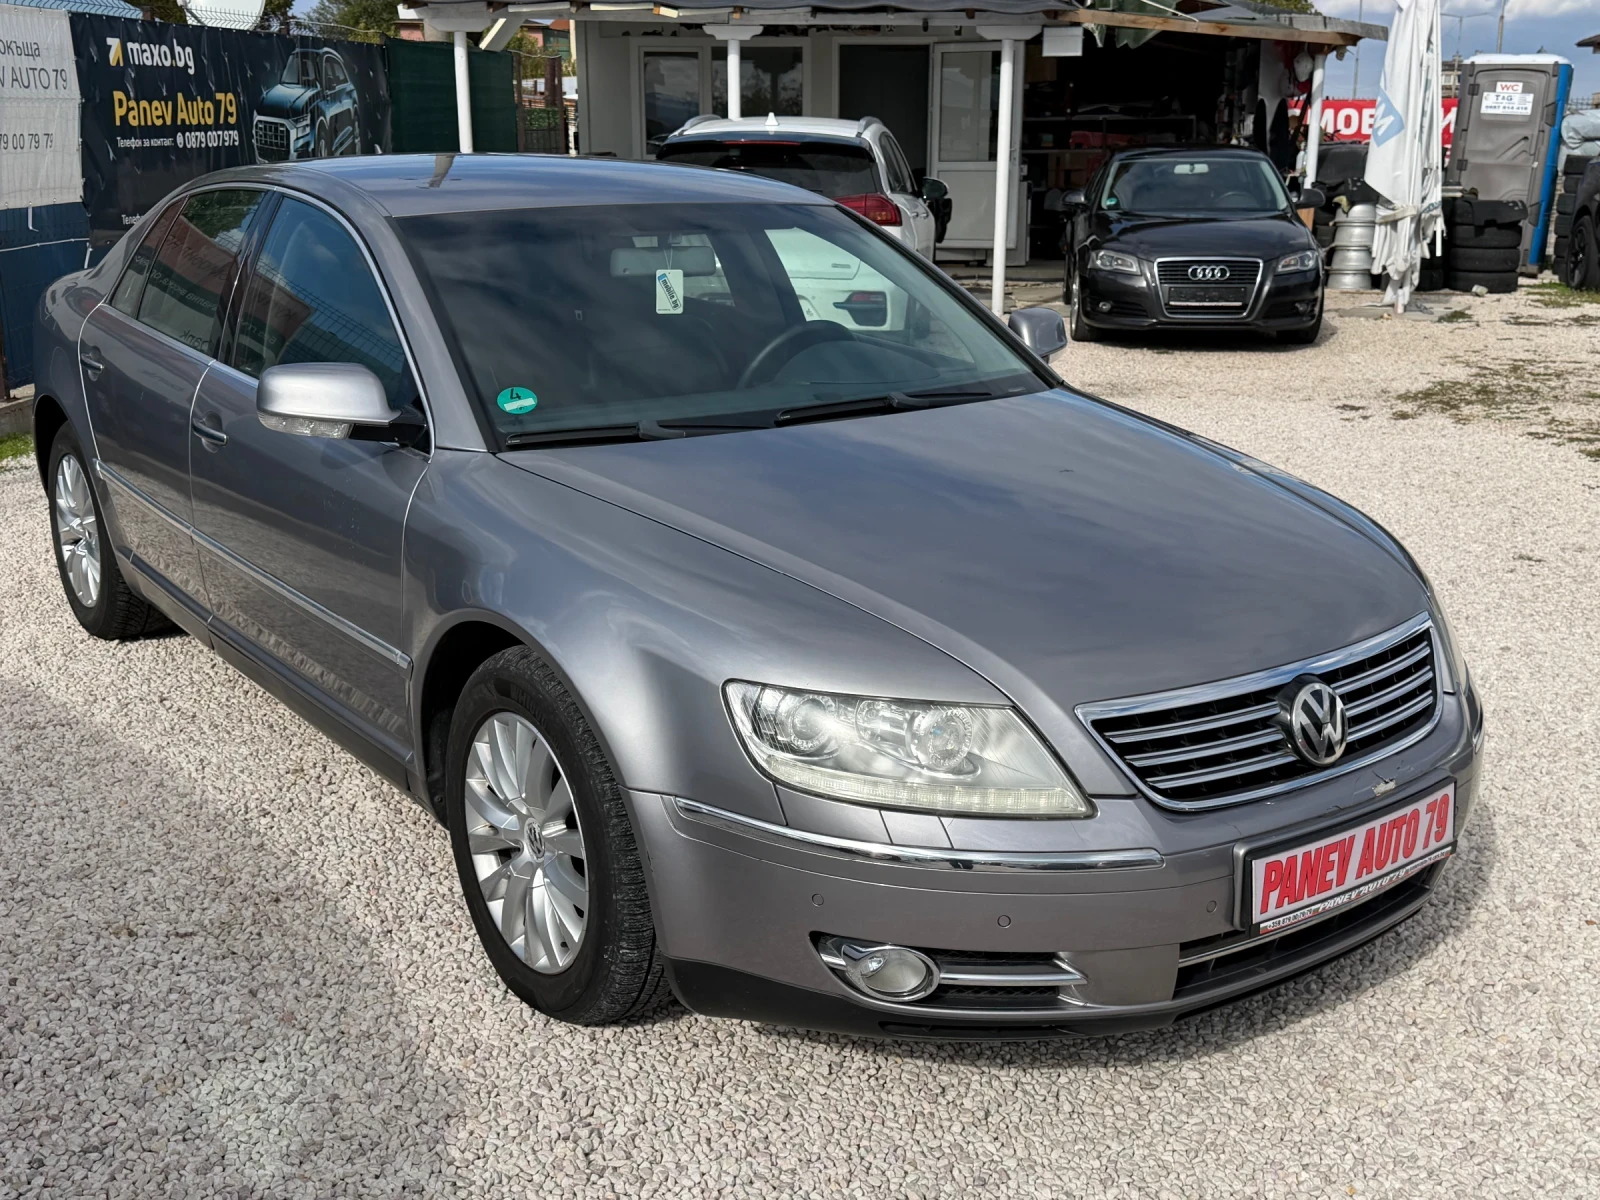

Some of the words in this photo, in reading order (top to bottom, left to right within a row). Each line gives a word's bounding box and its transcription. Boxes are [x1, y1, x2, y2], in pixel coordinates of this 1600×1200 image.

[127, 38, 195, 75] maxo.bg
[11, 66, 51, 90] AUTO
[52, 68, 67, 90] 79
[1500, 83, 1520, 92] WC
[112, 90, 172, 126] Panev
[177, 92, 214, 125] Auto
[215, 92, 237, 124] 79
[12, 133, 25, 150] 00
[28, 133, 40, 150] 79
[43, 133, 53, 149] 79
[117, 136, 142, 149] Телефон
[143, 138, 150, 147] за
[185, 131, 206, 148] 0879
[207, 130, 223, 147] 007
[223, 130, 239, 146] 979
[661, 278, 680, 309] mobile.bg
[510, 388, 522, 400] 4
[1260, 834, 1355, 915] PANEV
[1355, 808, 1420, 880] AUTO
[1422, 793, 1450, 850] 79
[1319, 889, 1360, 911] PANEV
[1360, 876, 1390, 896] AUTO
[1390, 867, 1406, 882] 79
